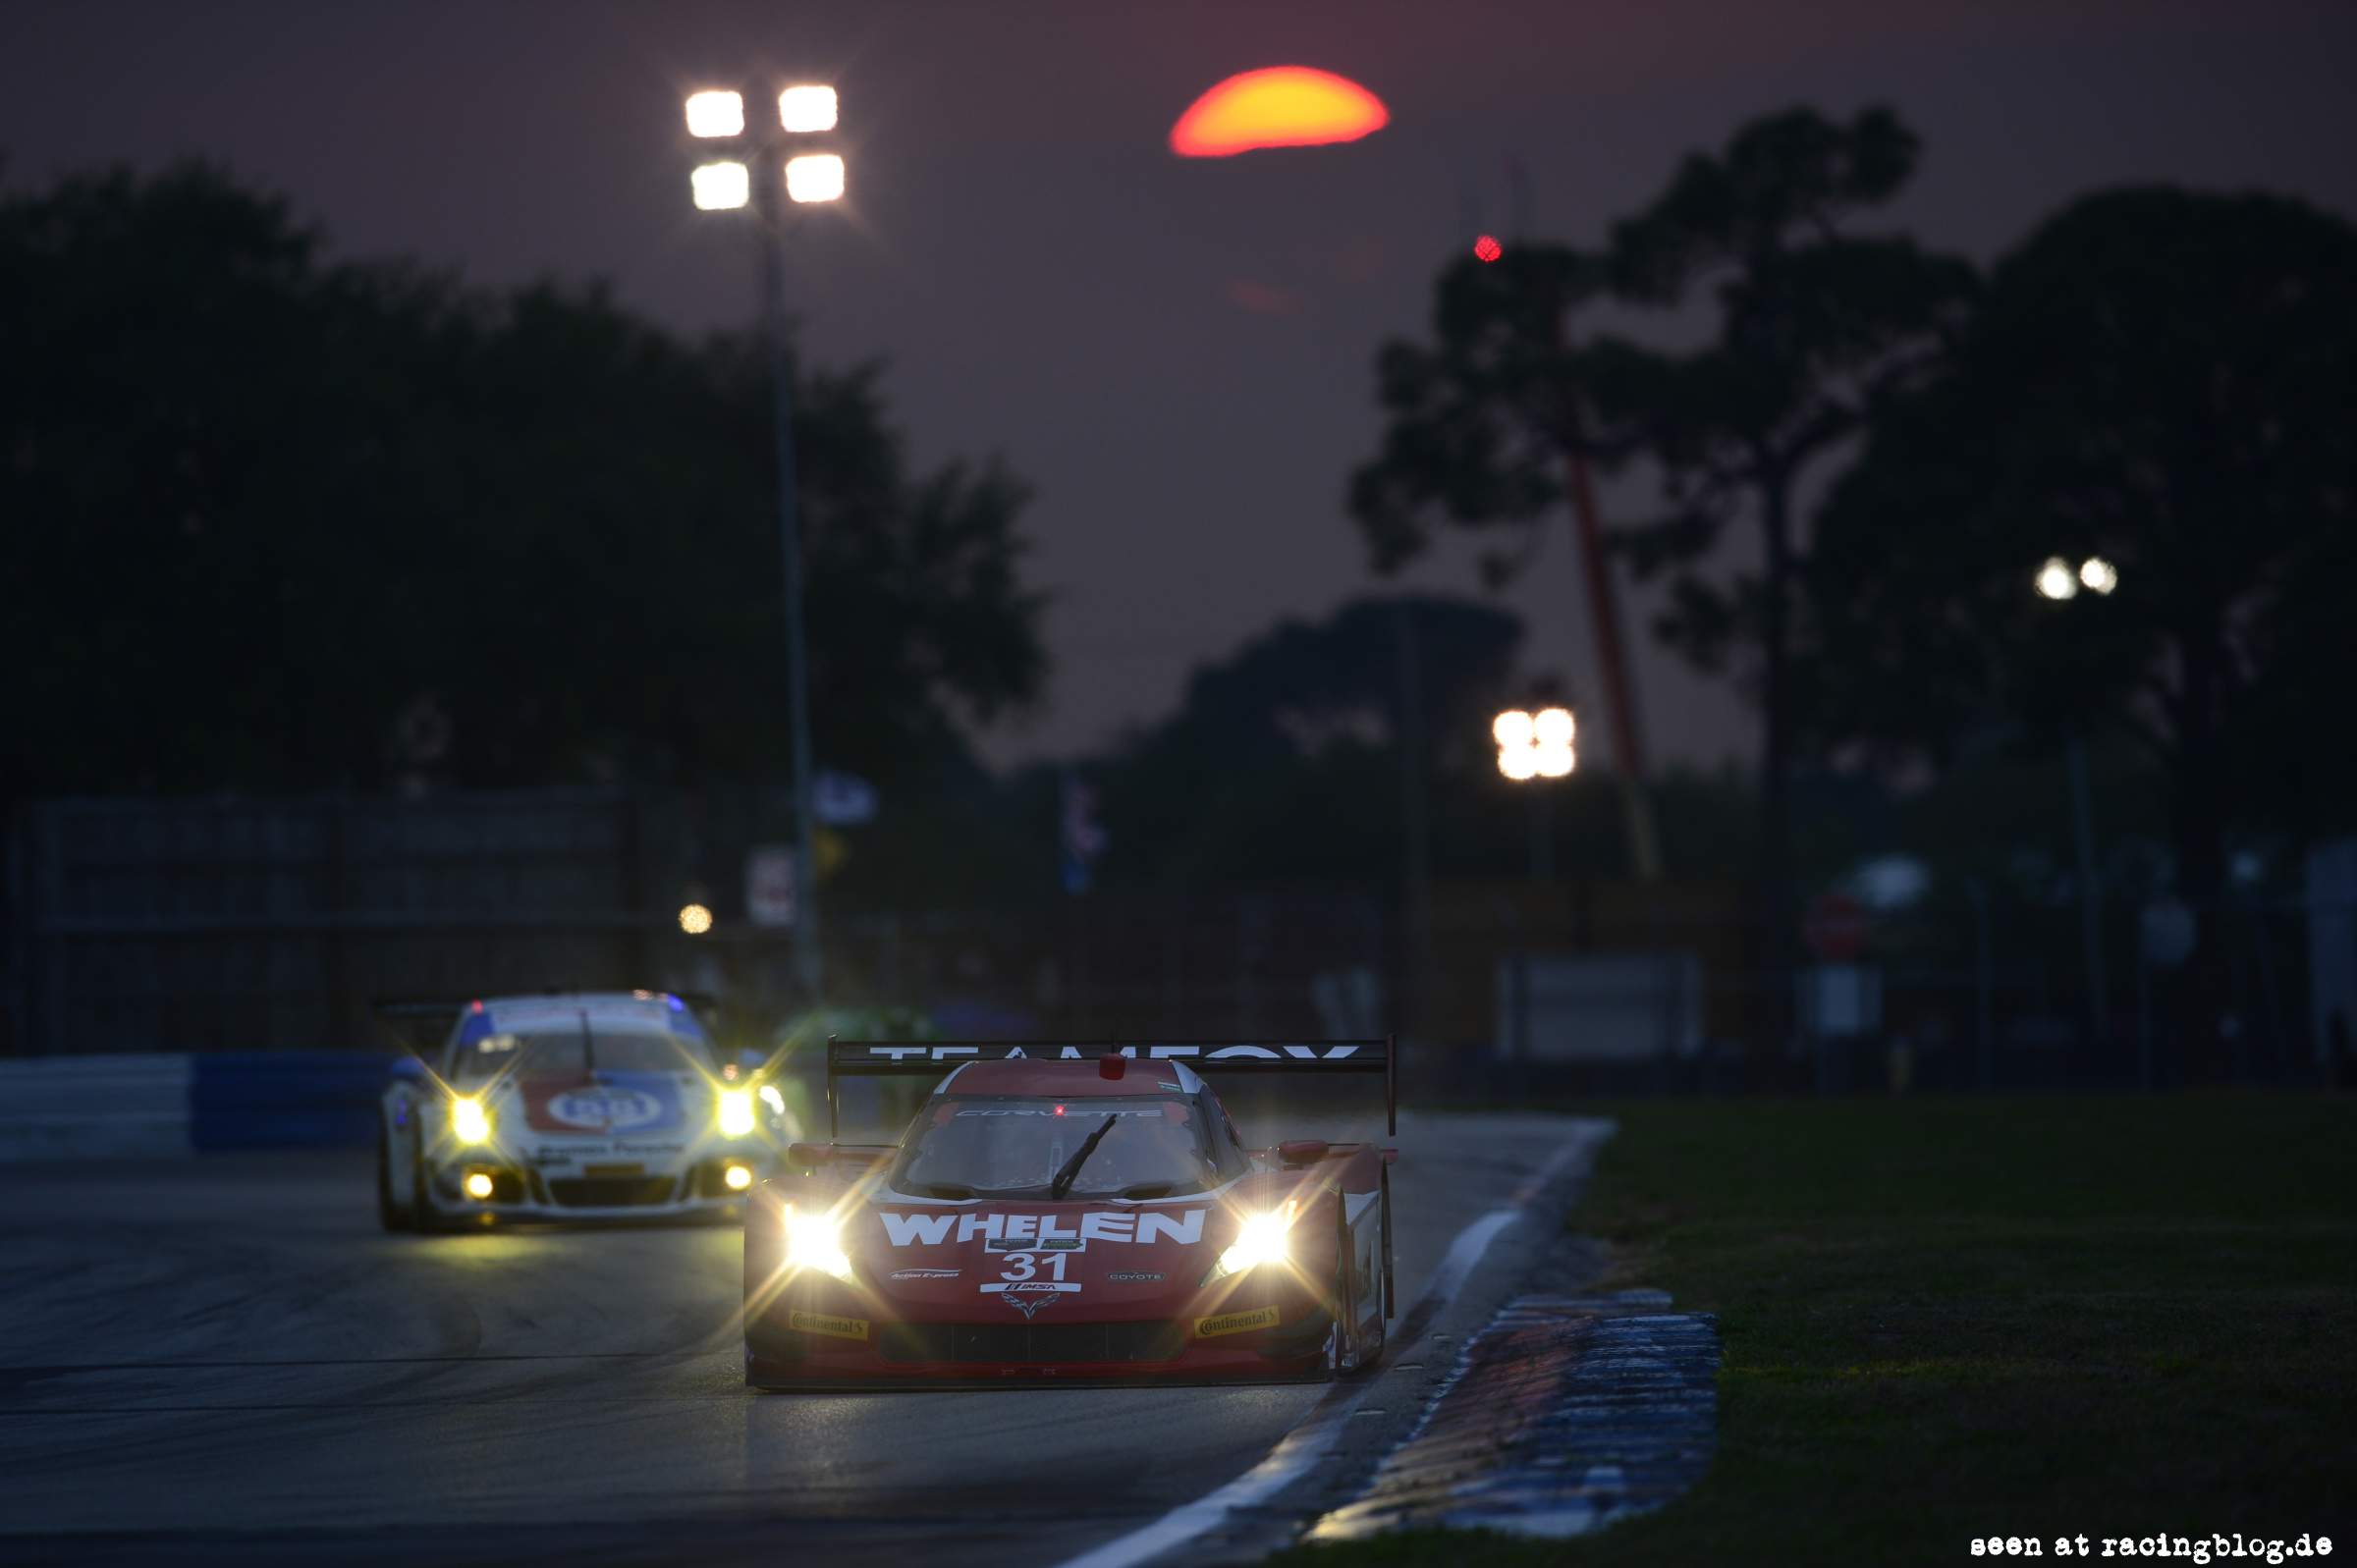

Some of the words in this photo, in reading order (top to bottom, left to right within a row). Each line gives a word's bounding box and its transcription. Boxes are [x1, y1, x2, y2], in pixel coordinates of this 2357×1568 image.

[879, 1209, 1206, 1246] WHELEN
[1000, 1253, 1068, 1281] 31
[1199, 1311, 1266, 1335] Continental
